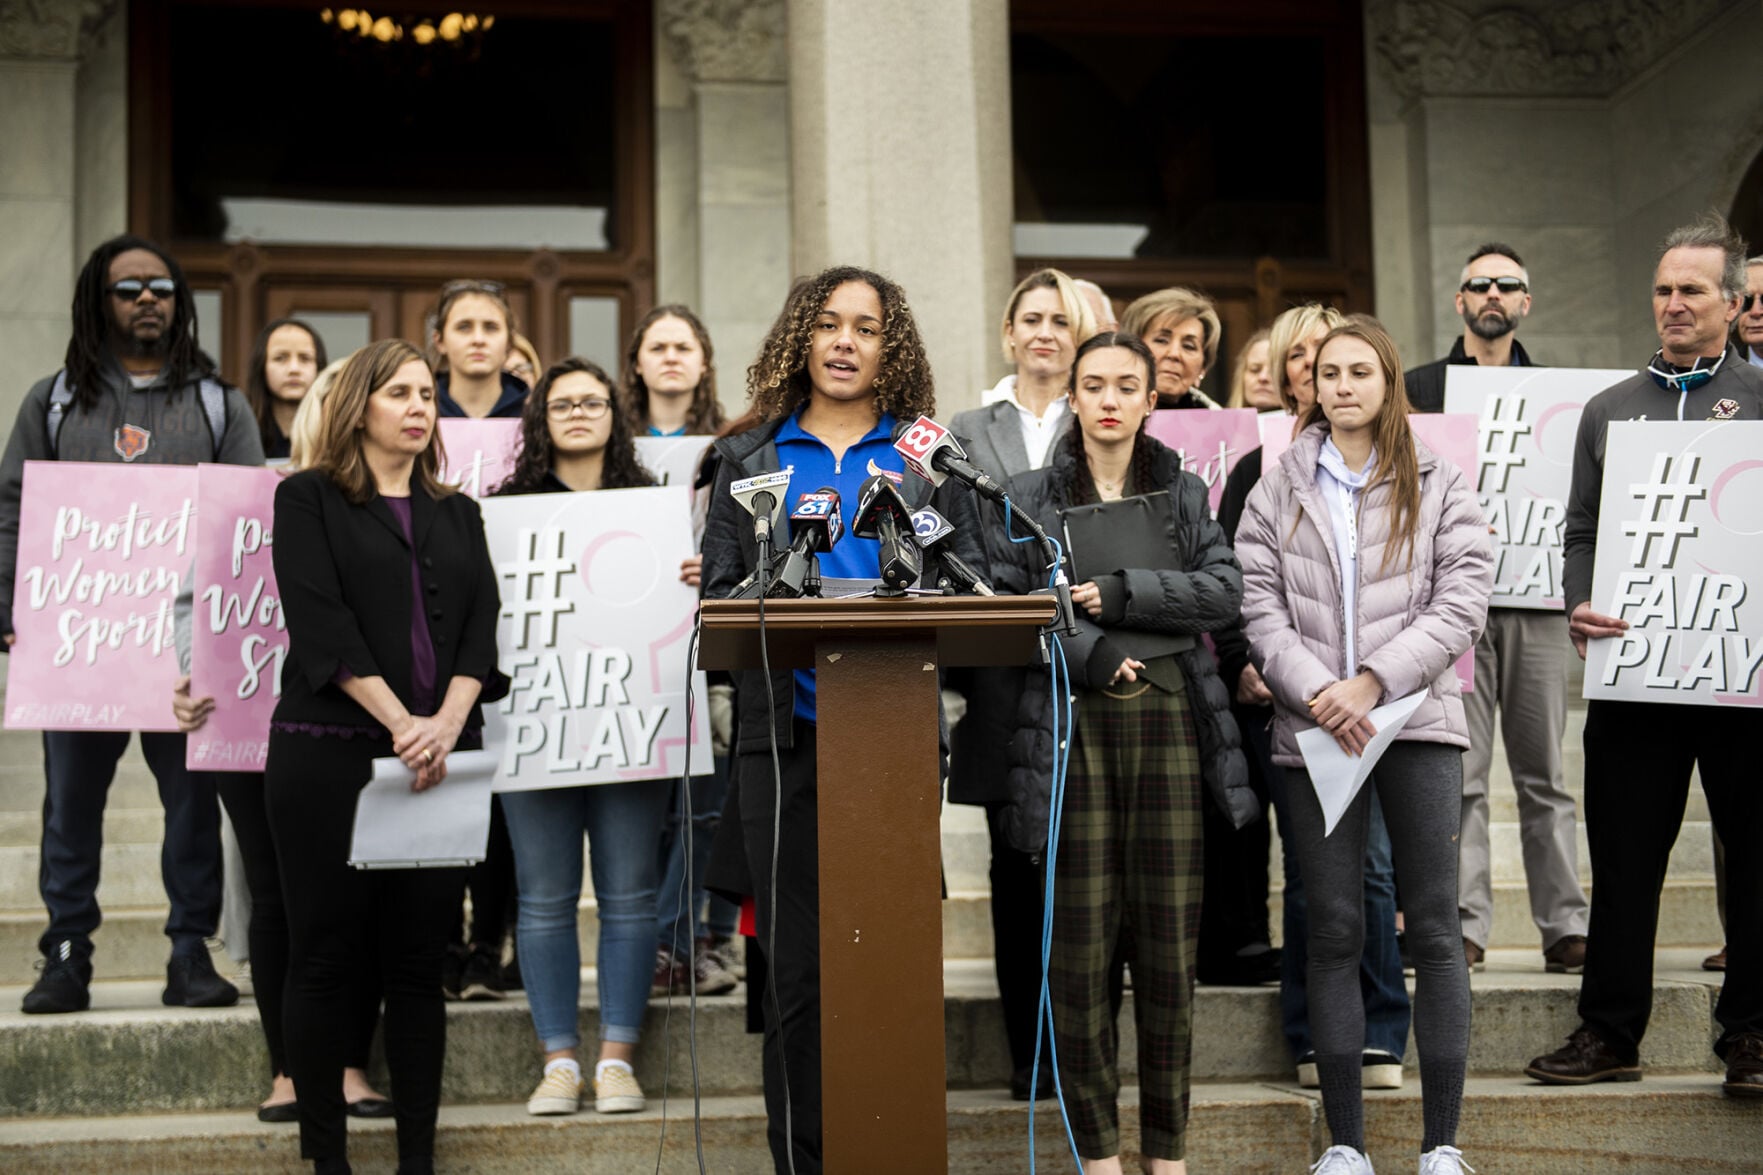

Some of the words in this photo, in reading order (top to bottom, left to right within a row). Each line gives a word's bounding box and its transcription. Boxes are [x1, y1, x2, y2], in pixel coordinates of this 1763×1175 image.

[905, 425, 938, 452] 8
[798, 501, 829, 515] 61
[803, 493, 832, 501] FOX
[860, 477, 881, 510] CT
[1478, 495, 1567, 547] AIR
[23, 558, 181, 610] Women
[1609, 572, 1747, 631] FAIR
[500, 648, 632, 714] FAIR
[1601, 631, 1763, 694] PLAY
[9, 703, 126, 724] #FAIRPLAY
[502, 705, 669, 777] PLAY
